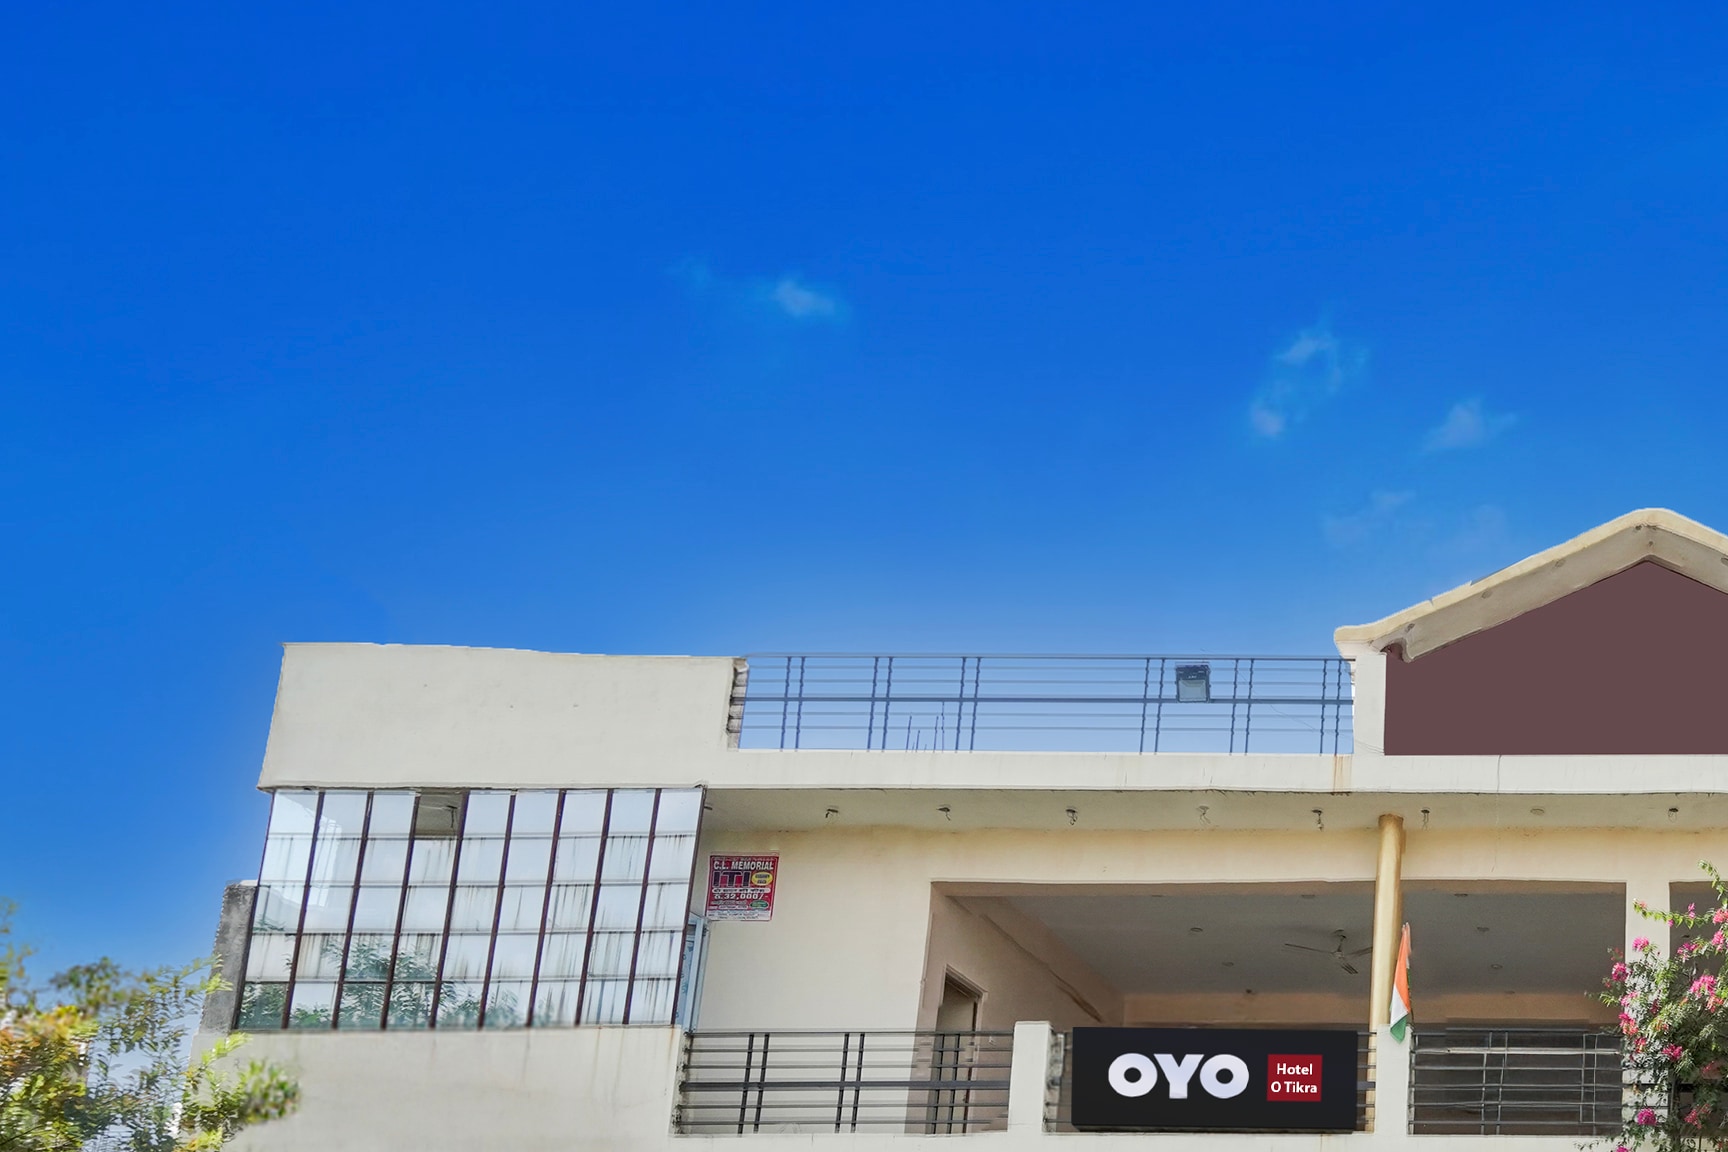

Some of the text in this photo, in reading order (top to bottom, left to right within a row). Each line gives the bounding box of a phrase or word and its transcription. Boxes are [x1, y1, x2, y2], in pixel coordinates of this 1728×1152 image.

[731, 861, 774, 870] MEMORIAL
[713, 871, 751, 887] ITI
[1108, 1052, 1250, 1099] OYO
[1276, 1063, 1313, 1076] Hotel
[1270, 1081, 1318, 1094] O Tikra
